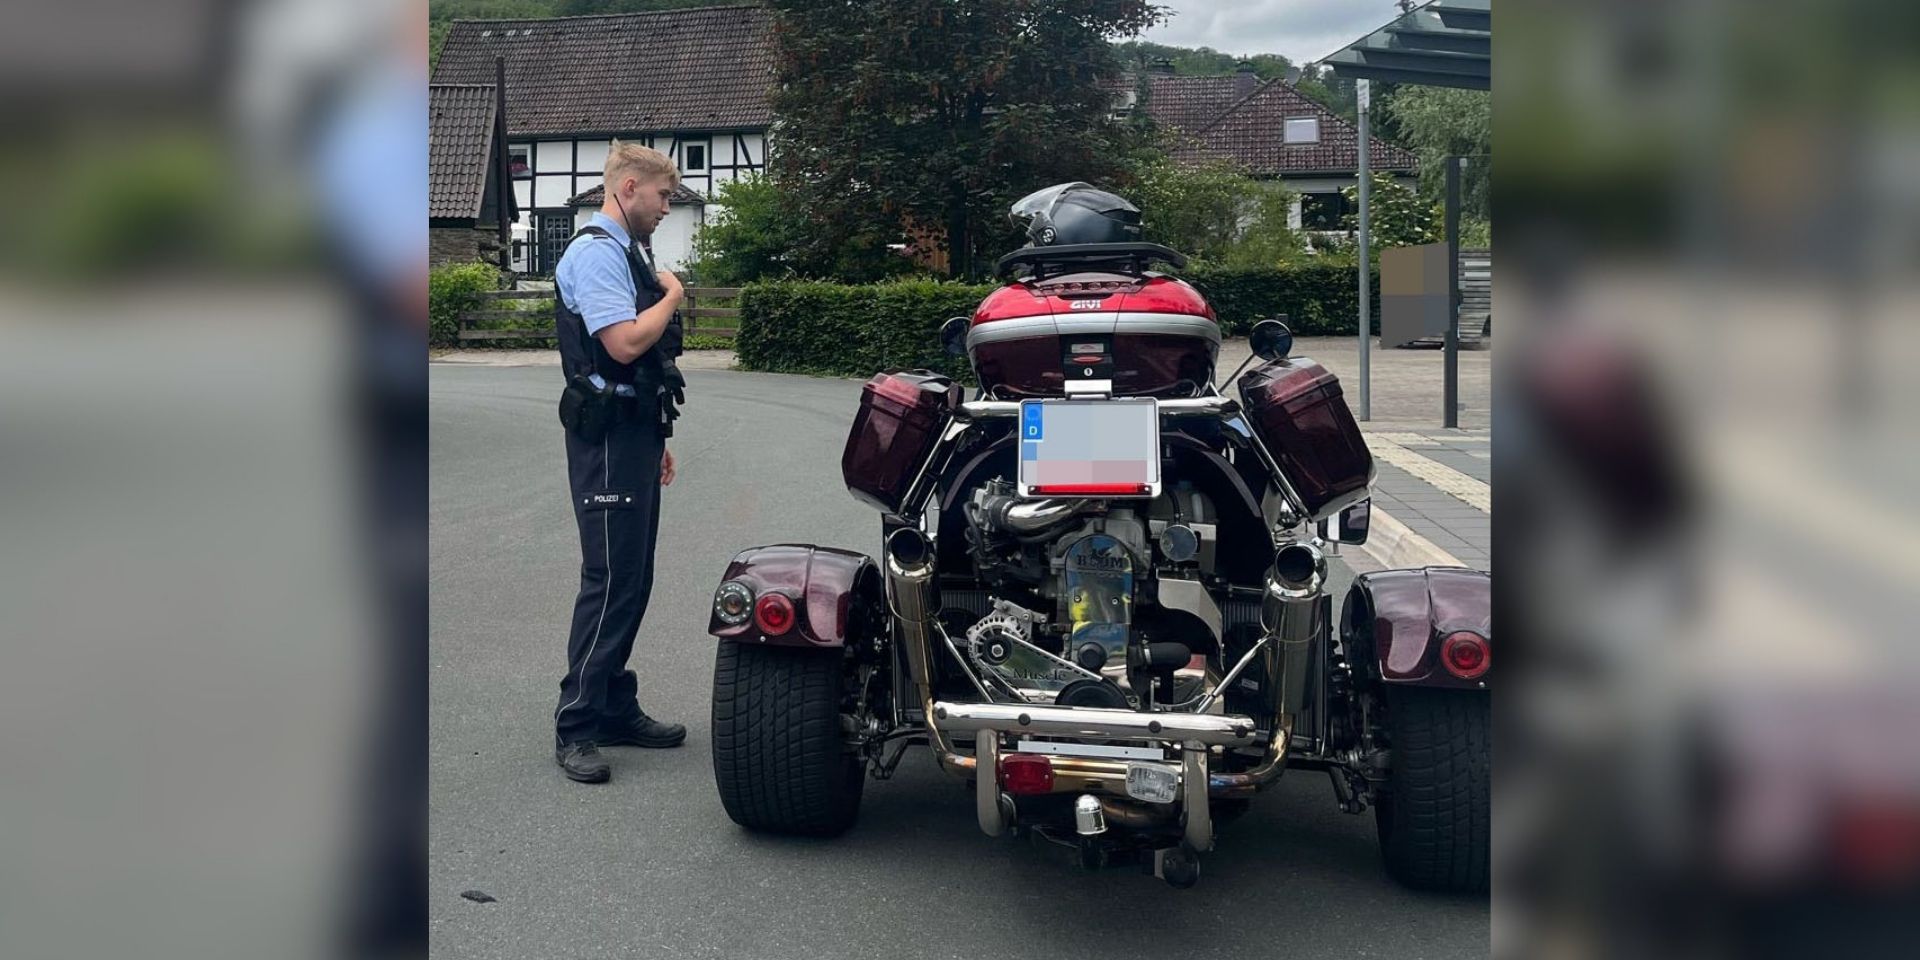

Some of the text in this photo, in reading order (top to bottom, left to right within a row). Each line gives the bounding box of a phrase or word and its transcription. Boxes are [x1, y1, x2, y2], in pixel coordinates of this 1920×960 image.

[1070, 300, 1101, 309] GIVI
[1029, 426, 1038, 436] D
[1013, 668, 1067, 681] Muscle
